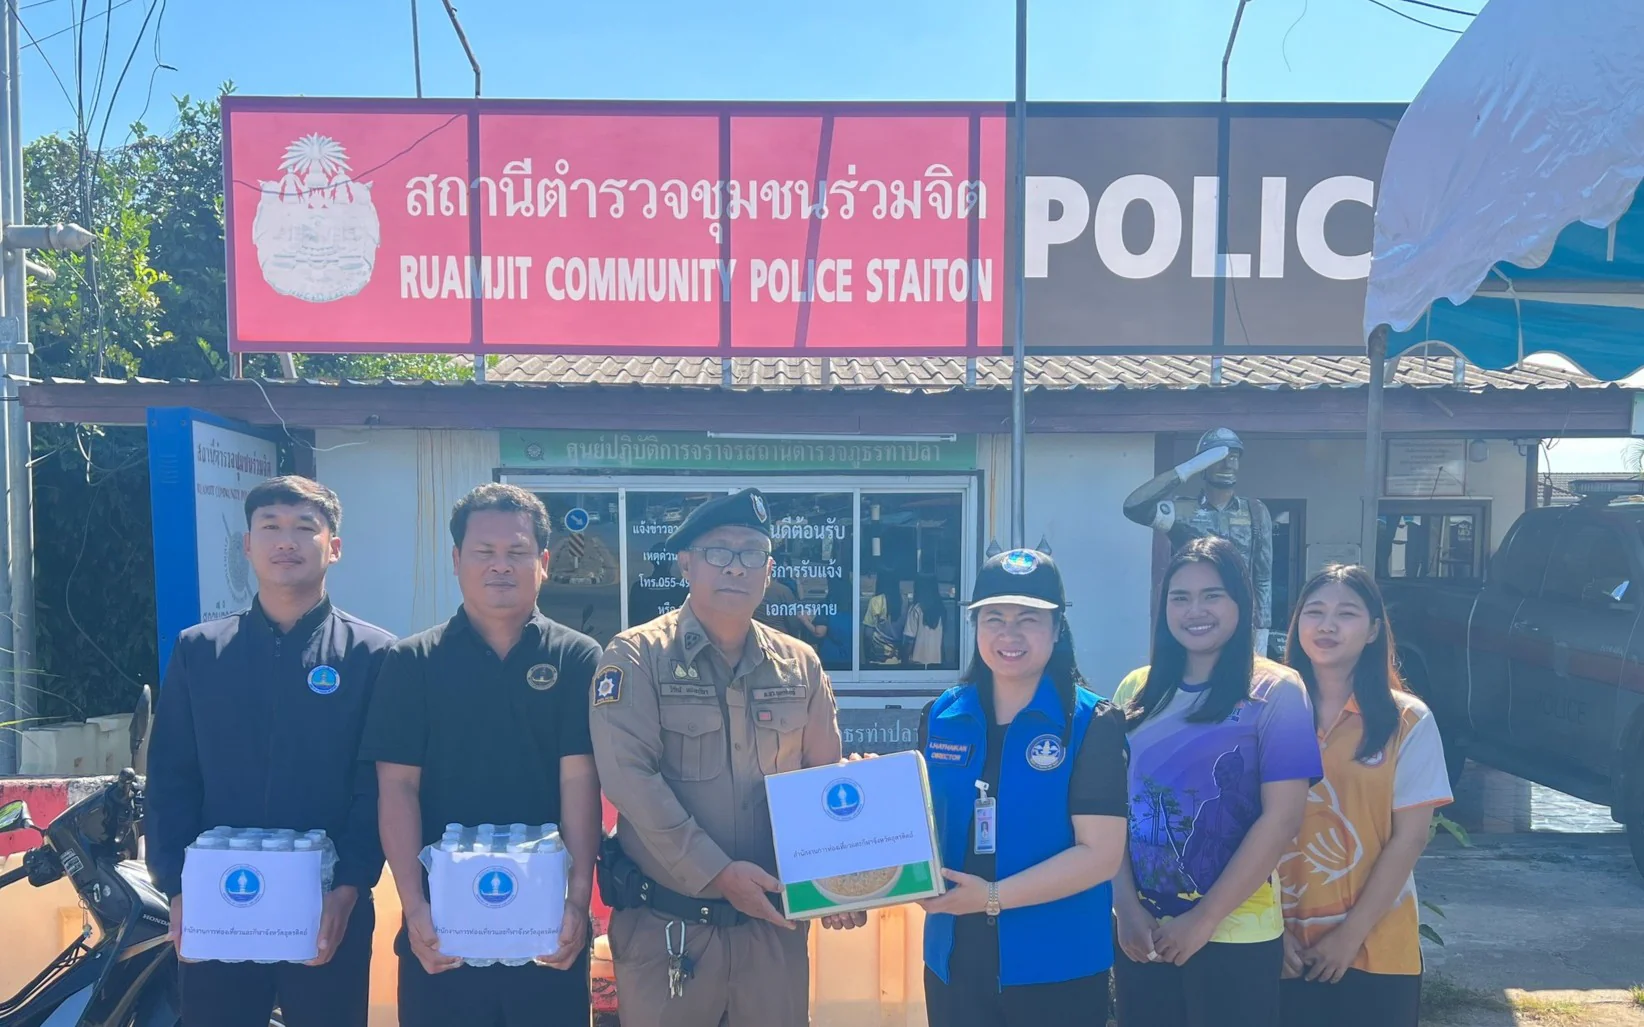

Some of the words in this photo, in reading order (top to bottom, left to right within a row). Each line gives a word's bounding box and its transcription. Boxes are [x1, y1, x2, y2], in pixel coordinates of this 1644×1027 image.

[405, 158, 987, 244] สถานีตำรวจชุมชนร่วมจิต
[1024, 173, 1375, 281] POLIC
[400, 255, 532, 300] RUAMJIT
[545, 256, 737, 302] COMMUNITY
[750, 257, 852, 303] POLICE
[866, 257, 992, 303] STAITON
[769, 516, 846, 540] นดีต้อนรับ
[766, 602, 838, 617] เอกสารหาย
[842, 719, 919, 744] ธรท่าปลา
